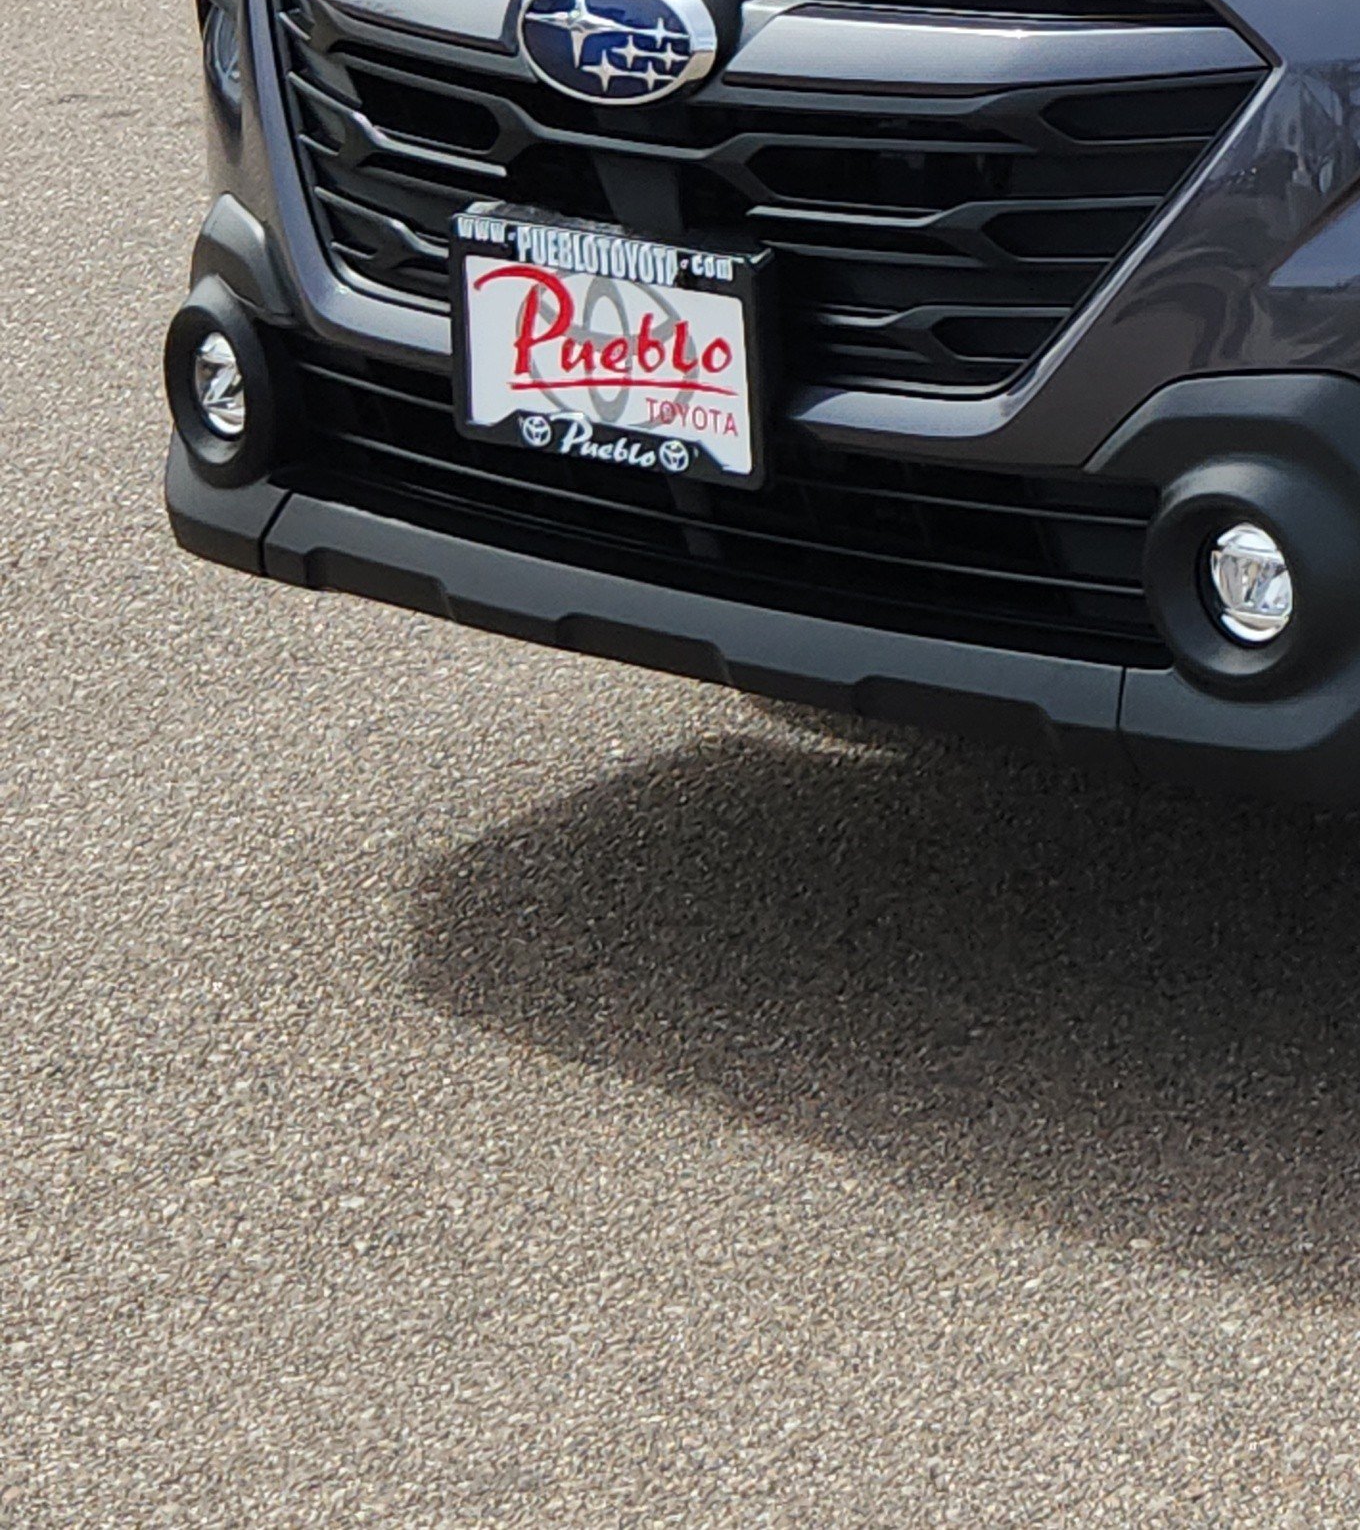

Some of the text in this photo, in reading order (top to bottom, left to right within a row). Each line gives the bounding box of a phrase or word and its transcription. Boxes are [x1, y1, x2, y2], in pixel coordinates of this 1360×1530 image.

[474, 265, 732, 375] Pueblo
[550, 411, 656, 467] Pueblo
[645, 397, 739, 437] TOYOTA
